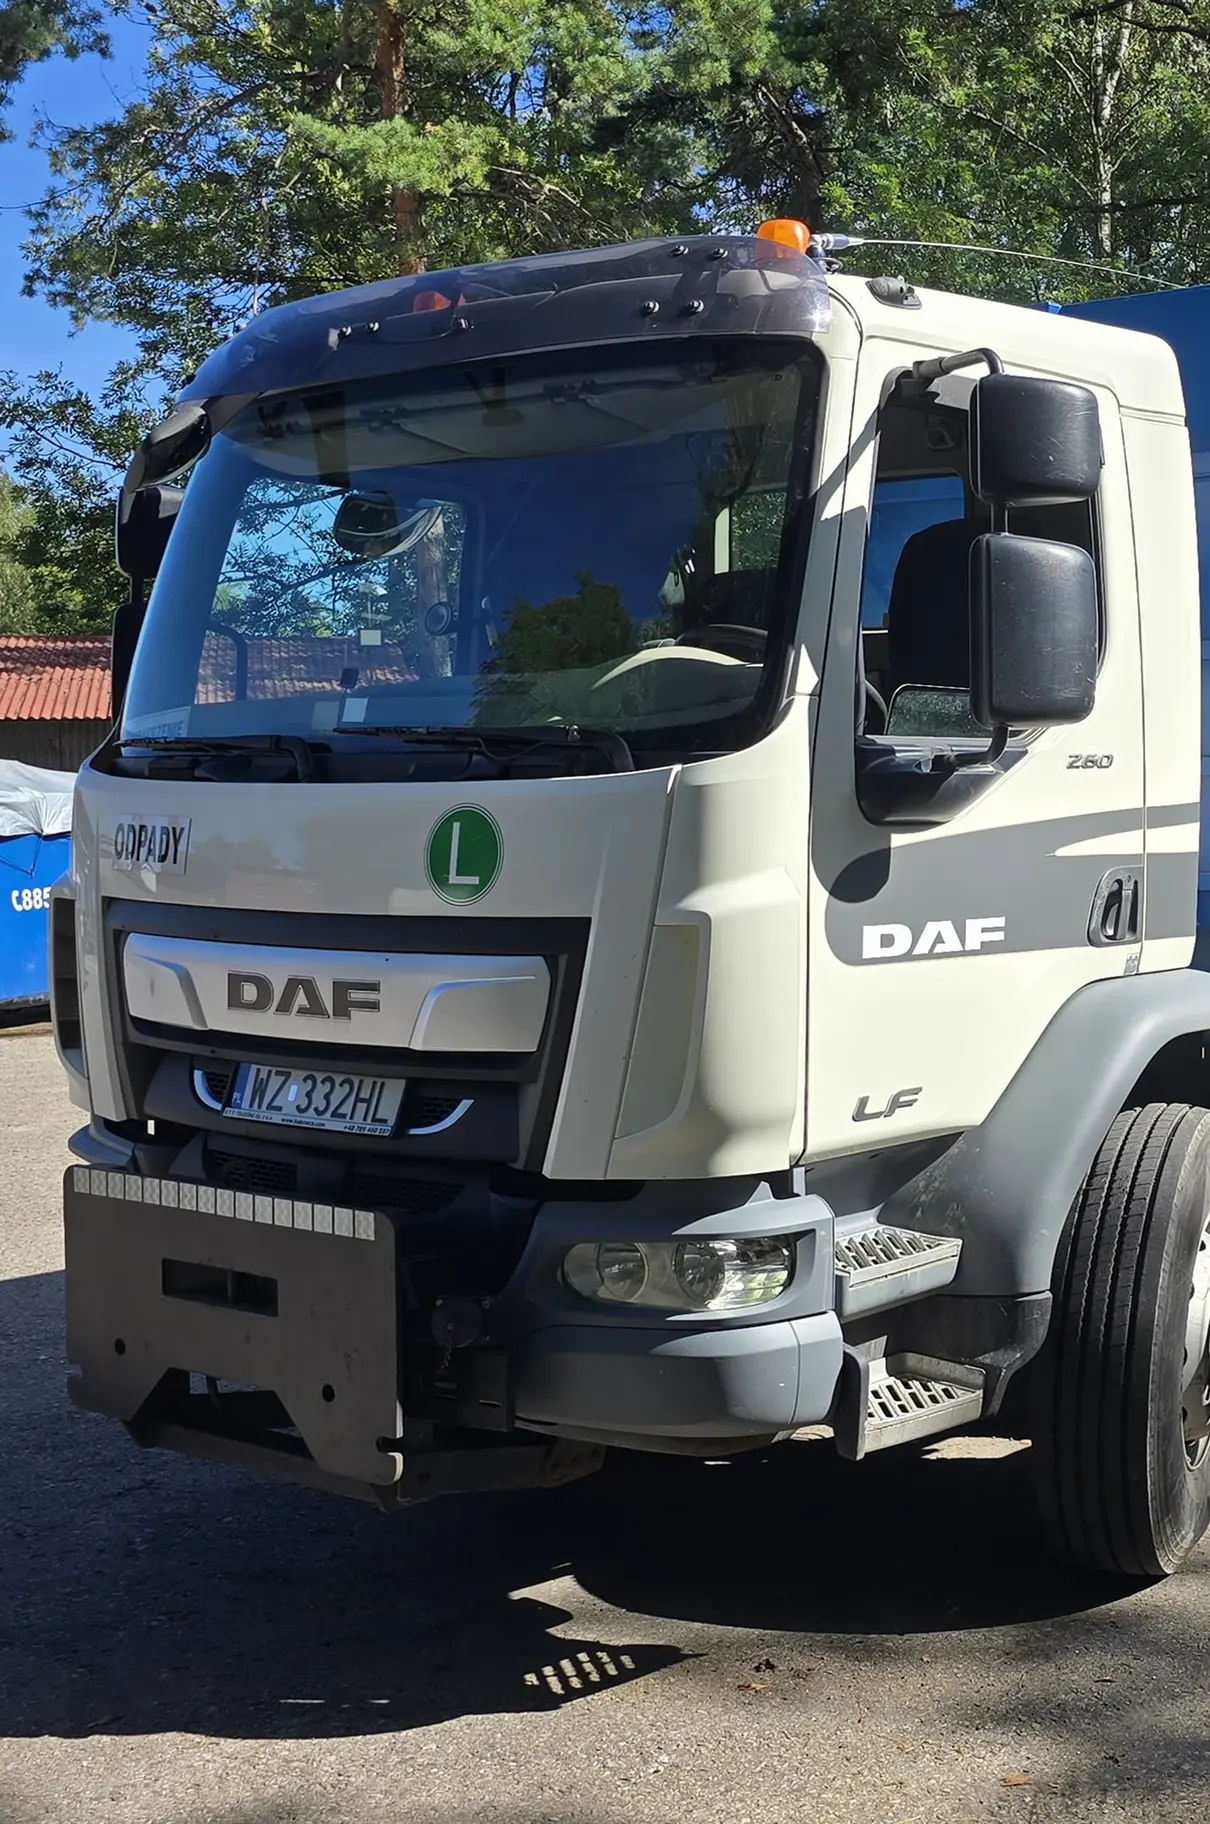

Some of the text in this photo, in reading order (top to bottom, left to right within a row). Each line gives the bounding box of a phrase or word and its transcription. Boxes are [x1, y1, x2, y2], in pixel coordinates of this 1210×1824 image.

[1066, 754, 1113, 769] 260
[114, 822, 185, 864] ODPADY
[448, 821, 480, 885] L
[862, 916, 1006, 959] DAF
[227, 969, 381, 1021] DAF
[249, 1067, 389, 1125] WZ 332HL
[852, 1086, 923, 1122] LF
